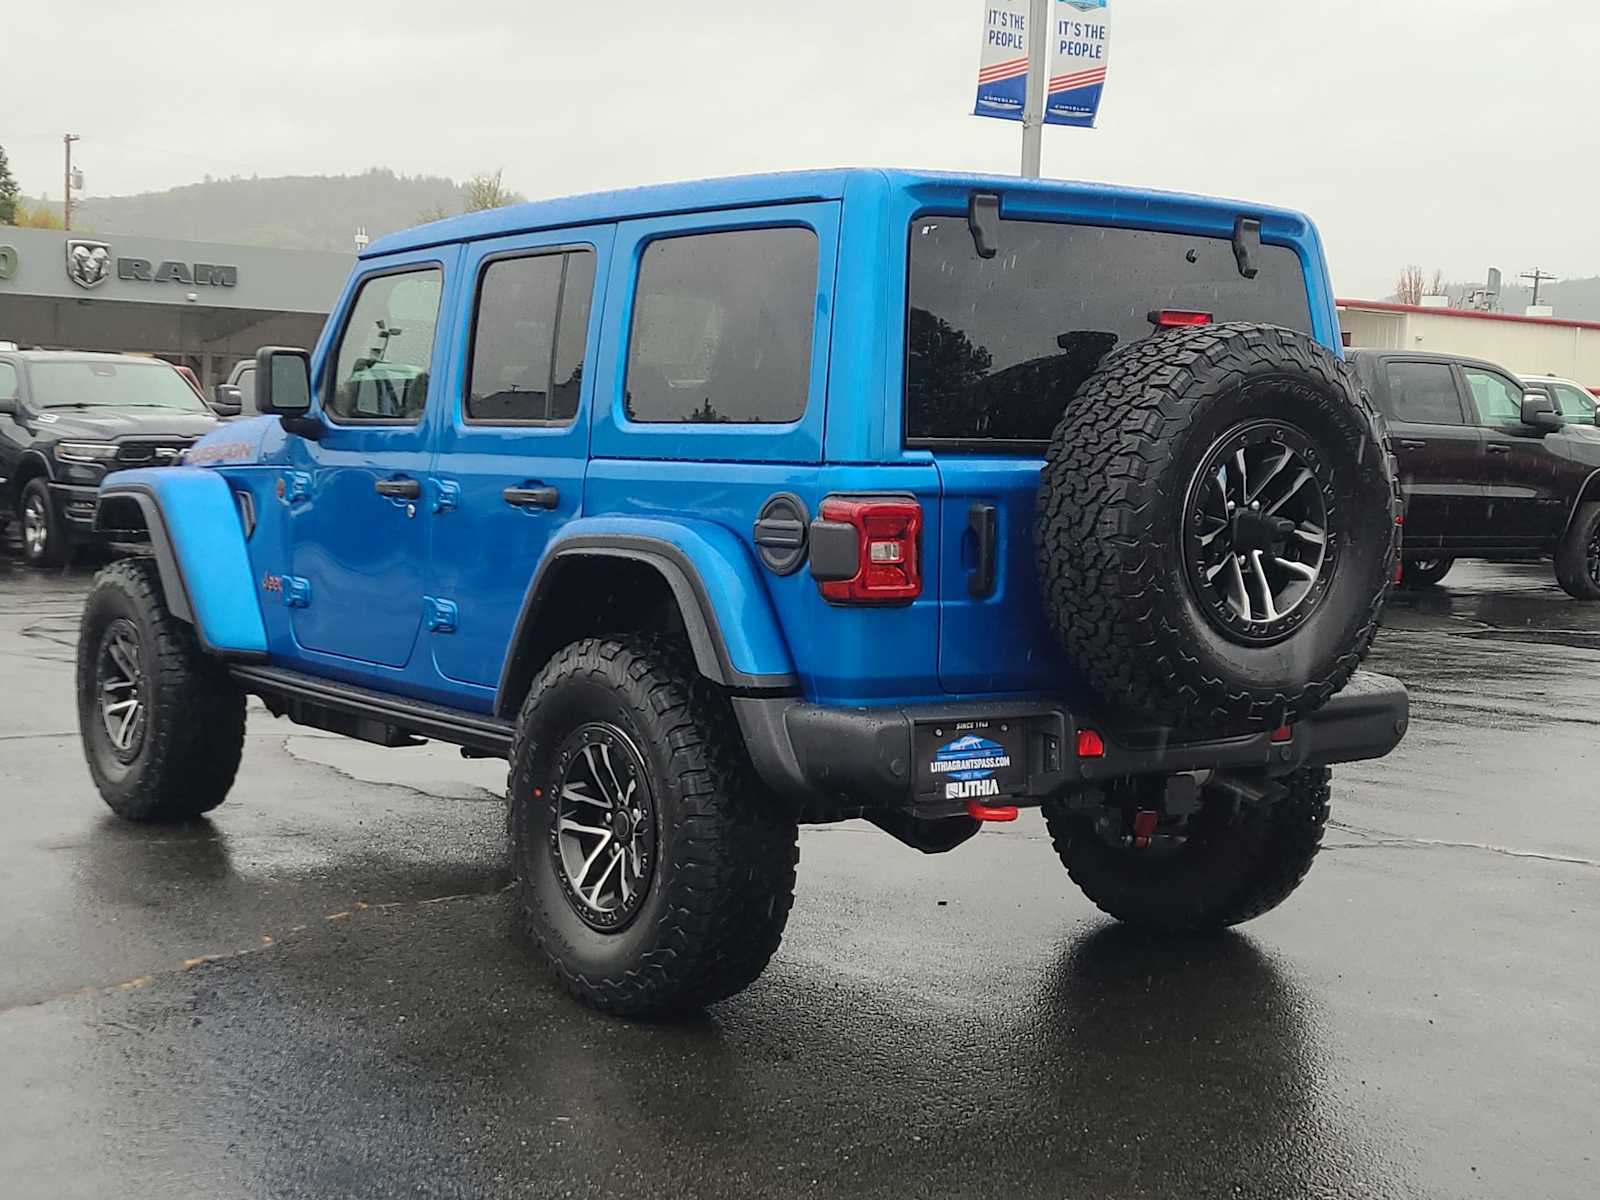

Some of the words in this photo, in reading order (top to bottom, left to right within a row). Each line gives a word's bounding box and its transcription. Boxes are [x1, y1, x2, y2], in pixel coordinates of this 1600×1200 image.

[988, 8, 1008, 26] IT'S
[1009, 13, 1025, 31] THE
[988, 29, 1024, 50] PEOPLE
[1058, 20, 1081, 37] IT'S
[1084, 23, 1105, 40] THE
[1059, 40, 1102, 59] PEOPLE
[117, 257, 238, 287] RAM
[930, 756, 1011, 773] LITHIAGRANTSPASS.COM
[958, 779, 1000, 798] LITHIA
